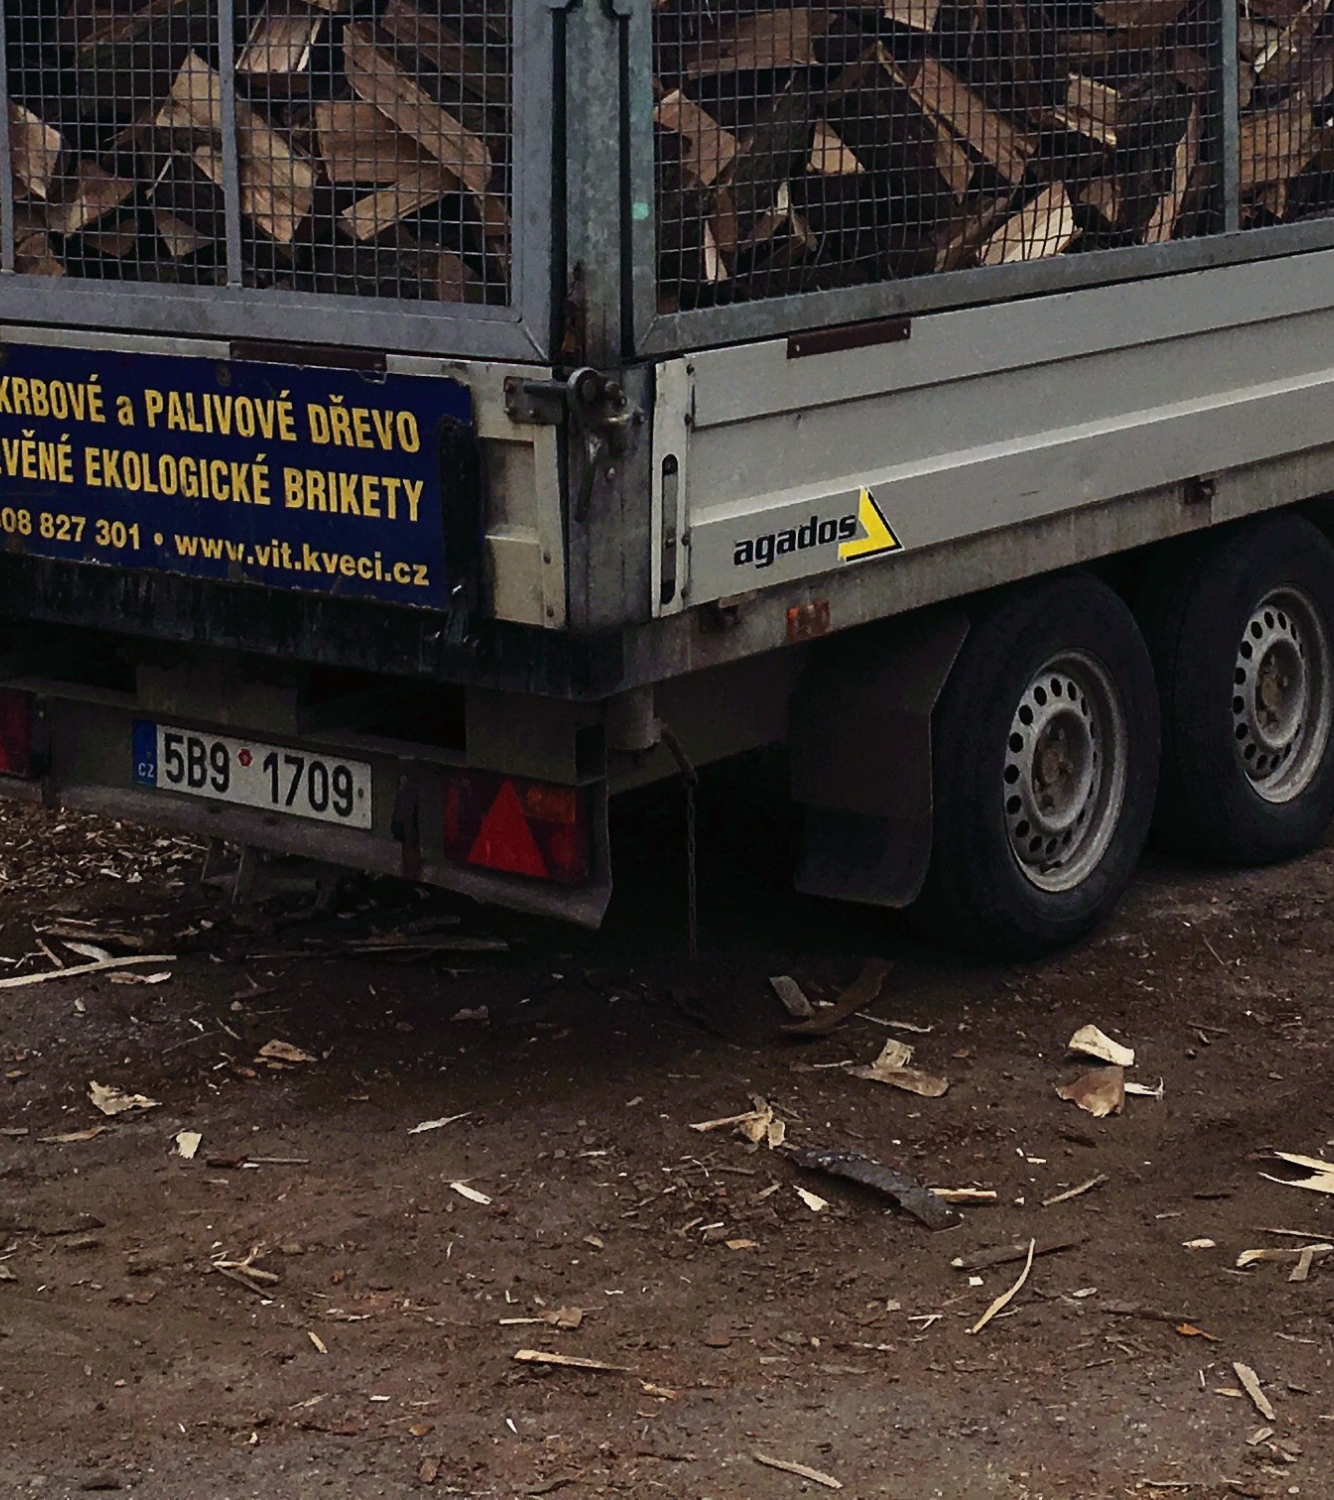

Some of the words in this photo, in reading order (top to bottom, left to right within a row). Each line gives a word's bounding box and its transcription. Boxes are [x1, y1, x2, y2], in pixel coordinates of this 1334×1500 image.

[116, 395, 135, 426] a
[144, 389, 297, 442] PALIVOVÉ
[307, 394, 420, 453] DŘEVO
[85, 447, 271, 506] EKOLOGICKÉ
[283, 467, 424, 522] BRIKETY
[39, 512, 86, 542] 827
[95, 519, 140, 550] 301
[174, 533, 430, 587] www.vit.kveci.cz
[733, 515, 857, 569] agados
[164, 732, 230, 793] 5B9
[262, 752, 354, 817] 1709
